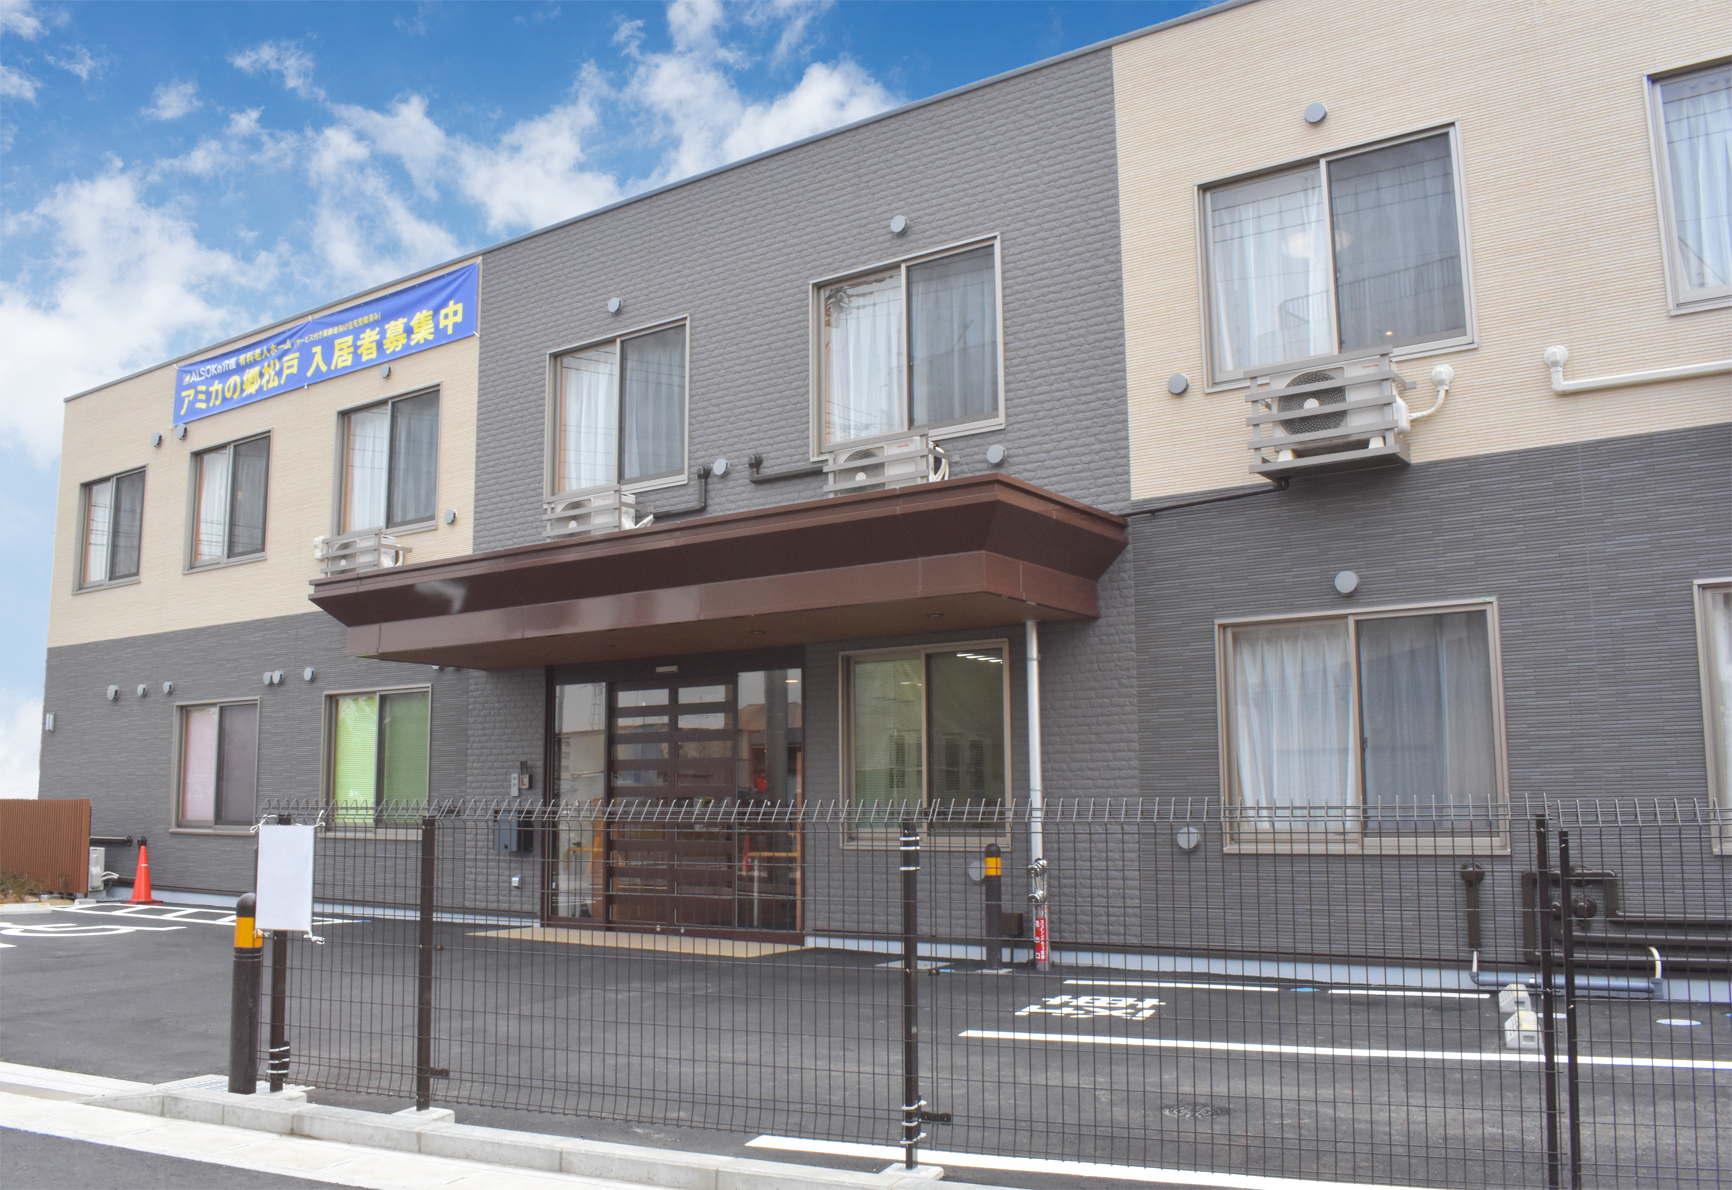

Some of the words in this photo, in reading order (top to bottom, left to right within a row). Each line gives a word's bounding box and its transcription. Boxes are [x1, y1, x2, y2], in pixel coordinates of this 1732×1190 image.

[179, 352, 300, 416] アミカの郷松戸
[306, 299, 464, 377] 入居者募集中
[239, 339, 292, 366] 有料老人ホーム
